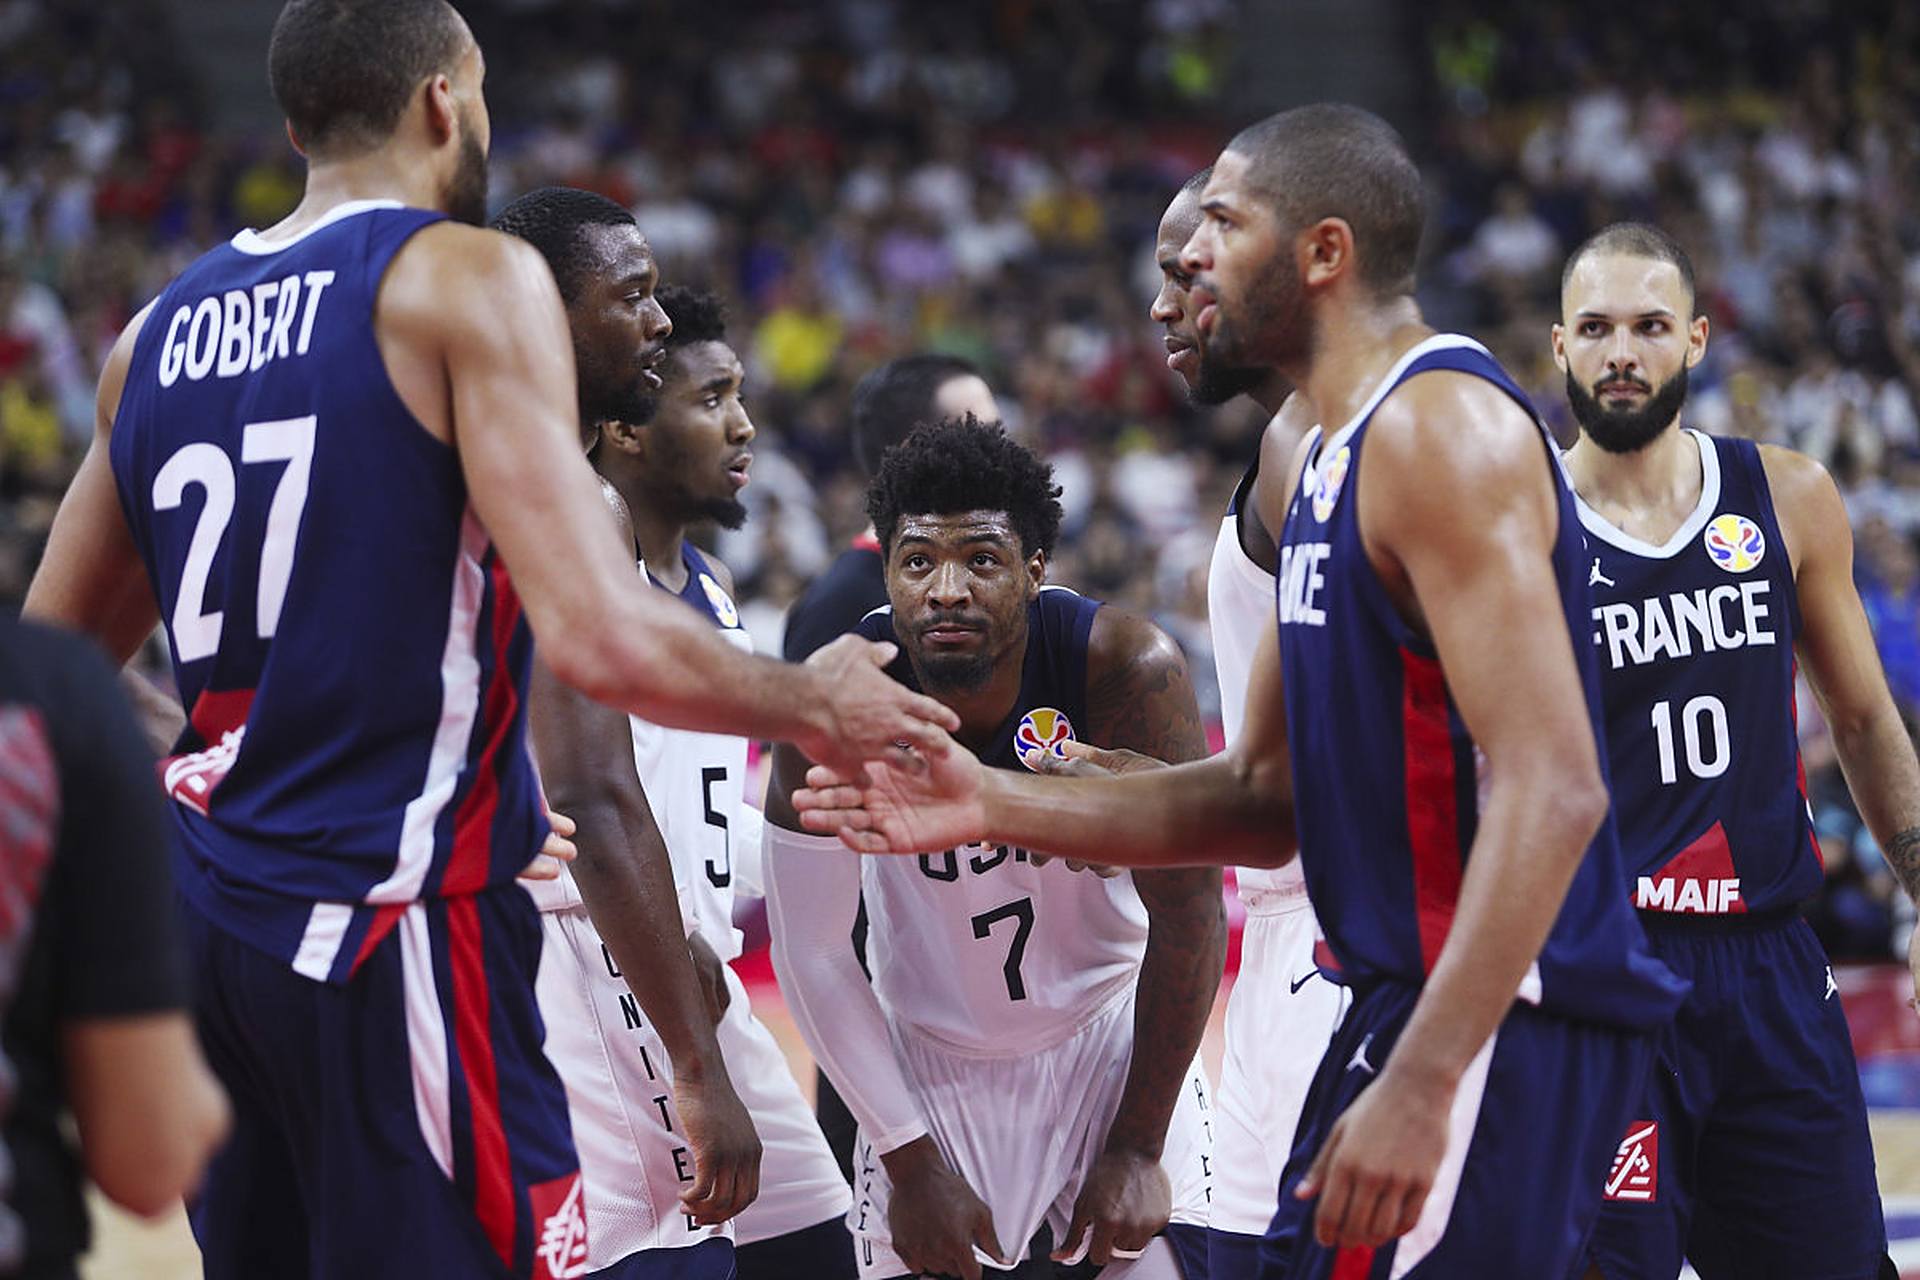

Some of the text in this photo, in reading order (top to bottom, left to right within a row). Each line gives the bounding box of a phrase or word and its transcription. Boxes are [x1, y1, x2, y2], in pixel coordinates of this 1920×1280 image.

[158, 270, 336, 388] GOBERT
[152, 414, 318, 663] 27
[1651, 695, 1732, 785] 10
[702, 767, 730, 888] 5
[971, 897, 1034, 1001] 7
[1636, 876, 1740, 913] MAIF
[601, 943, 700, 1231] NITE
